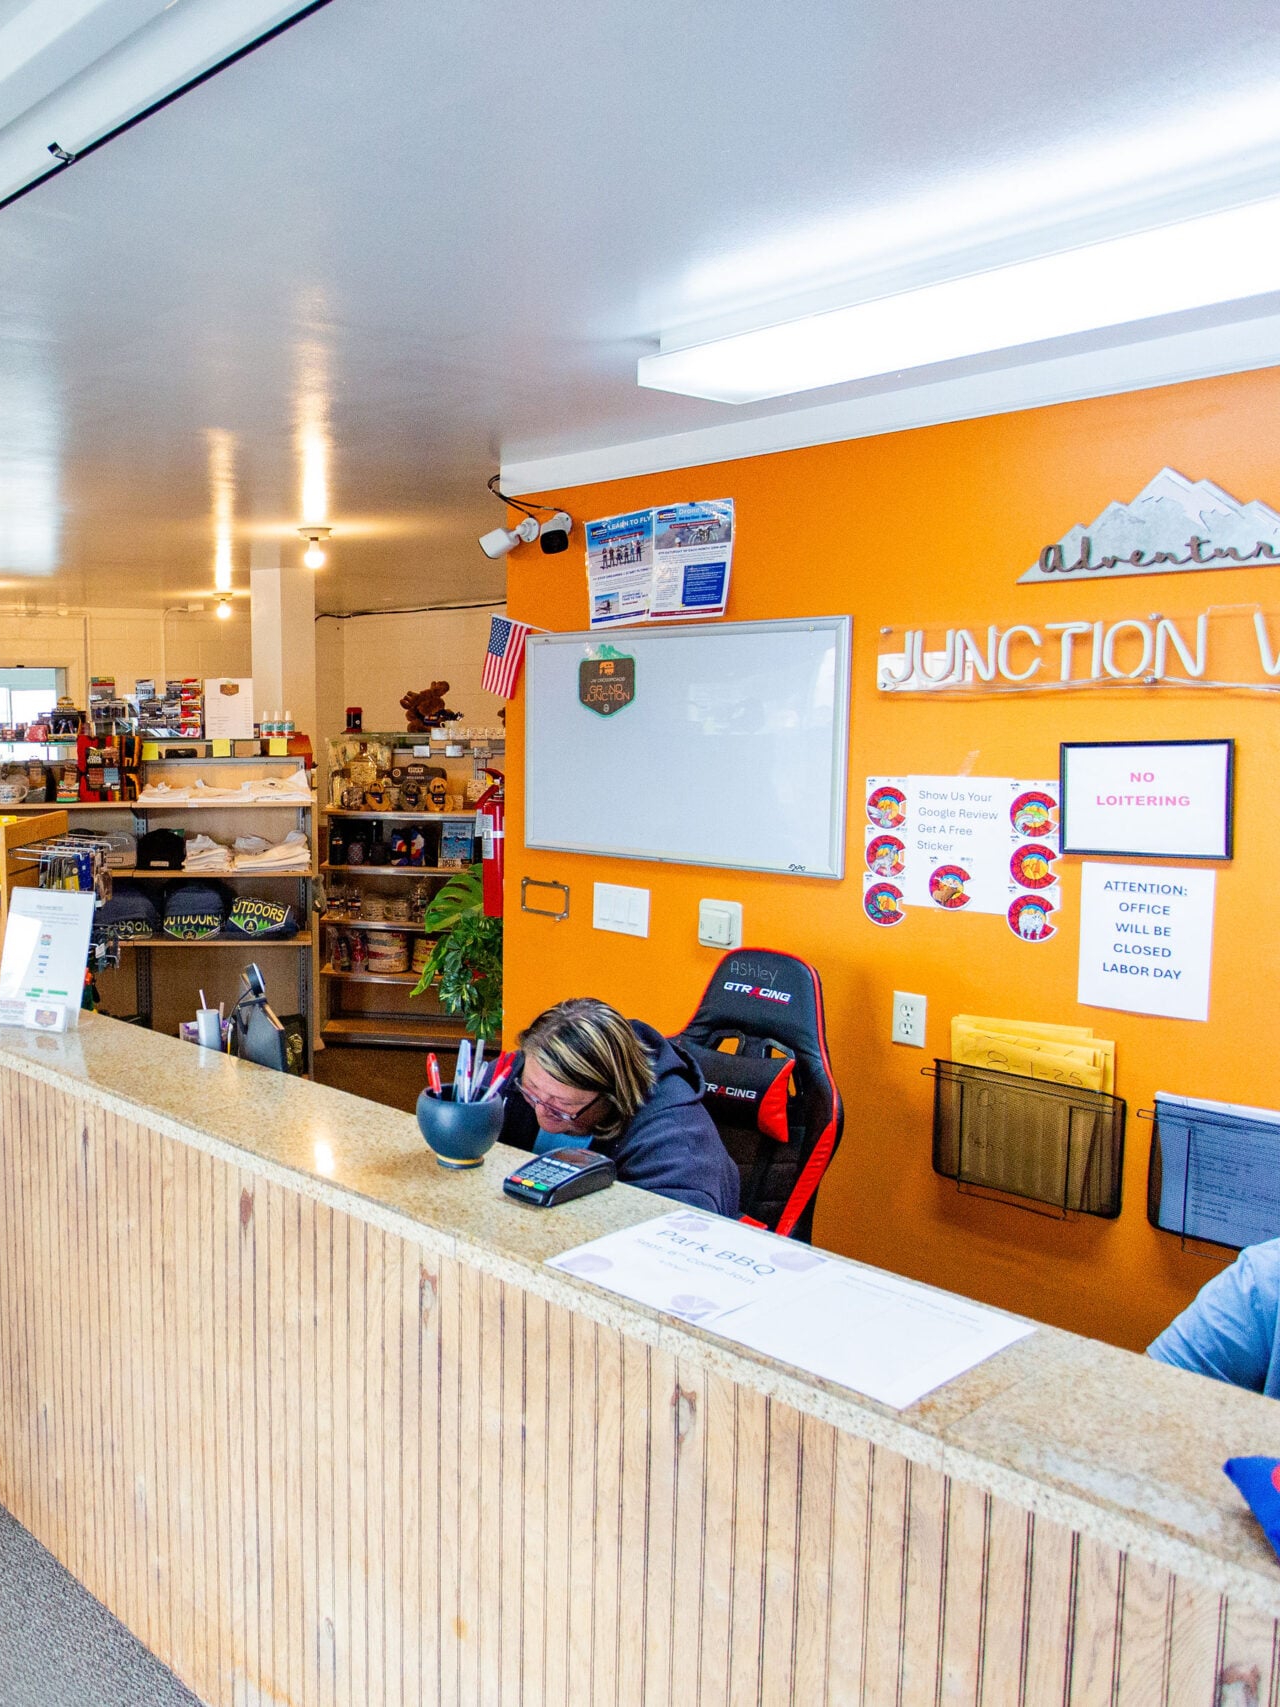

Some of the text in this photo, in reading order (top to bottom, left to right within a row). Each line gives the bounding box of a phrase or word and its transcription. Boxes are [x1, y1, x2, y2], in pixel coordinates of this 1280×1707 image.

[880, 614, 1208, 684] JUNCTION
[583, 691, 630, 702] JUNCTION
[1129, 771, 1155, 783] NO
[918, 790, 993, 802] Show Us Your
[1096, 795, 1191, 807] LOITERING
[918, 807, 998, 820] Google Review
[917, 823, 973, 836] Get A Free
[916, 840, 954, 852] Sticker
[1103, 879, 1188, 897] ATTENTION:
[1118, 902, 1171, 916] OFFICE
[1115, 921, 1172, 937] WILL BE
[1113, 942, 1172, 958] CLOSED
[1102, 961, 1182, 981] LABOR DAY
[723, 981, 792, 1004] GTRACING
[656, 1229, 714, 1254] Park
[714, 1249, 776, 1277] BBQ
